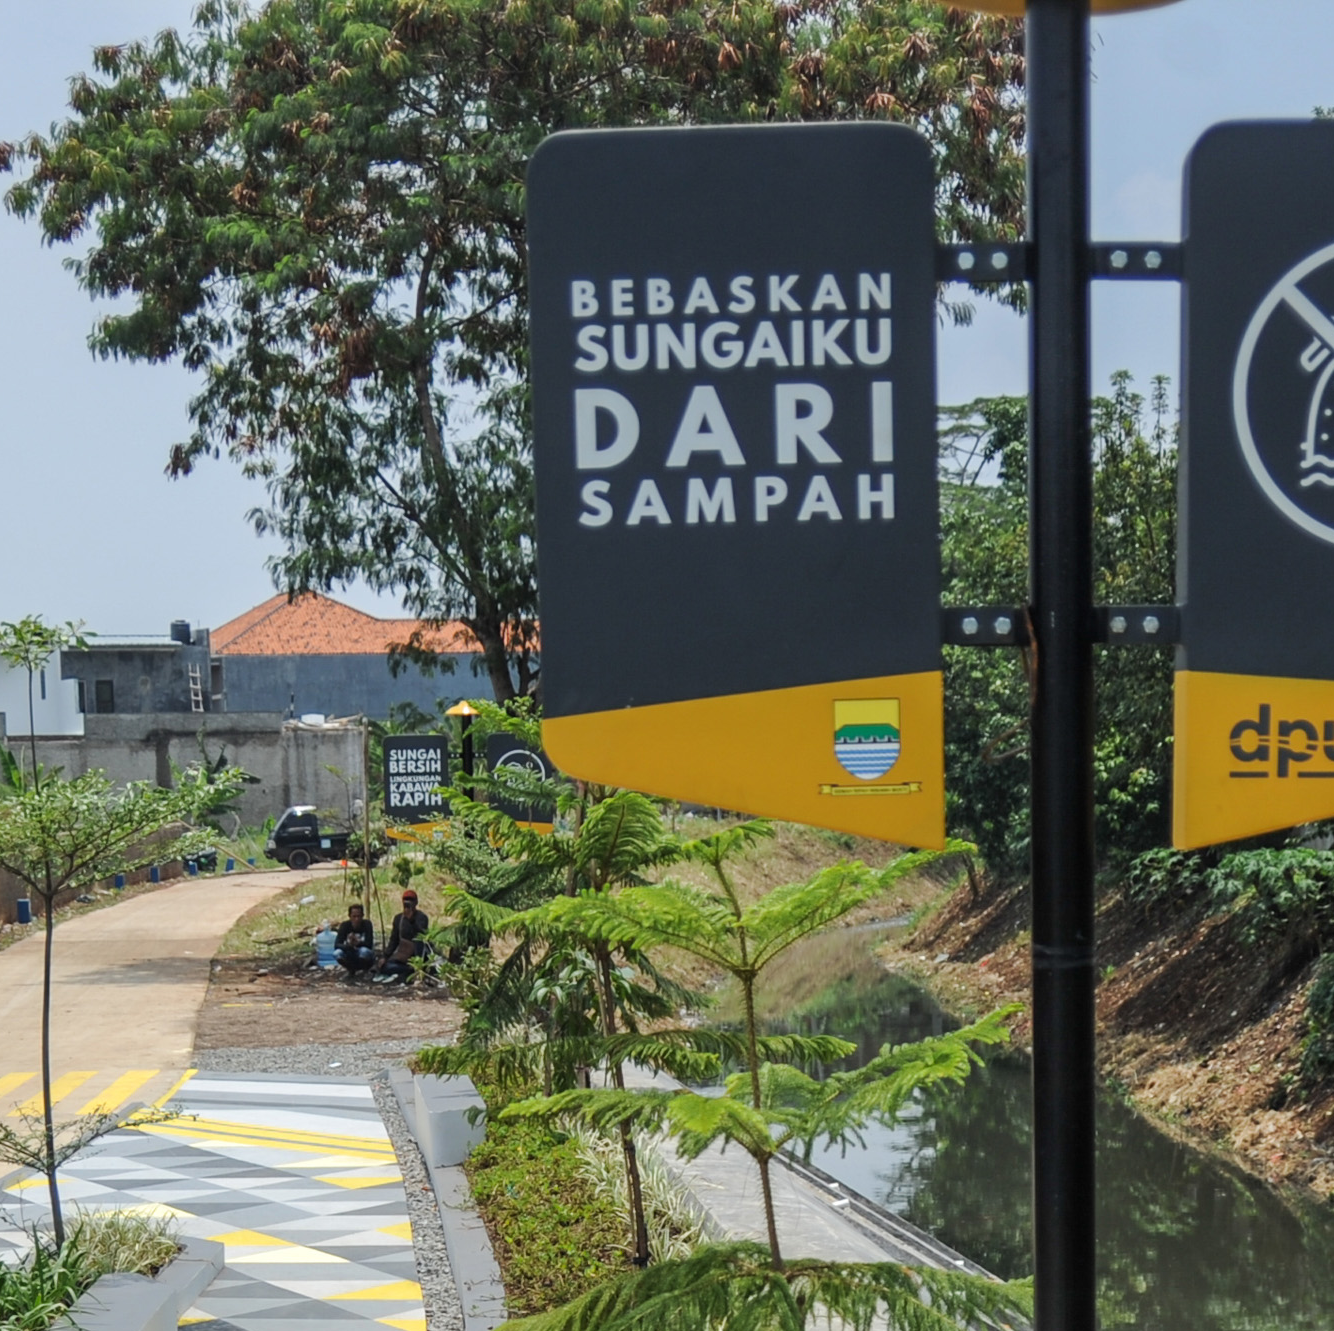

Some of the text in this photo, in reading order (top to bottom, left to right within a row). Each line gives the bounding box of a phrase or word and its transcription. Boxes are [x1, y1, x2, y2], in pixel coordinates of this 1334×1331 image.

[571, 273, 892, 317] BEBASKAN
[574, 318, 893, 372] SUNGAIKU
[574, 381, 894, 469] DARI
[577, 473, 895, 528] SAMPAH
[389, 748, 441, 760] SUNGAI
[389, 760, 442, 773] BERSIH
[389, 775, 442, 783] LINGKUNGAN
[390, 792, 442, 807] RAPIH
